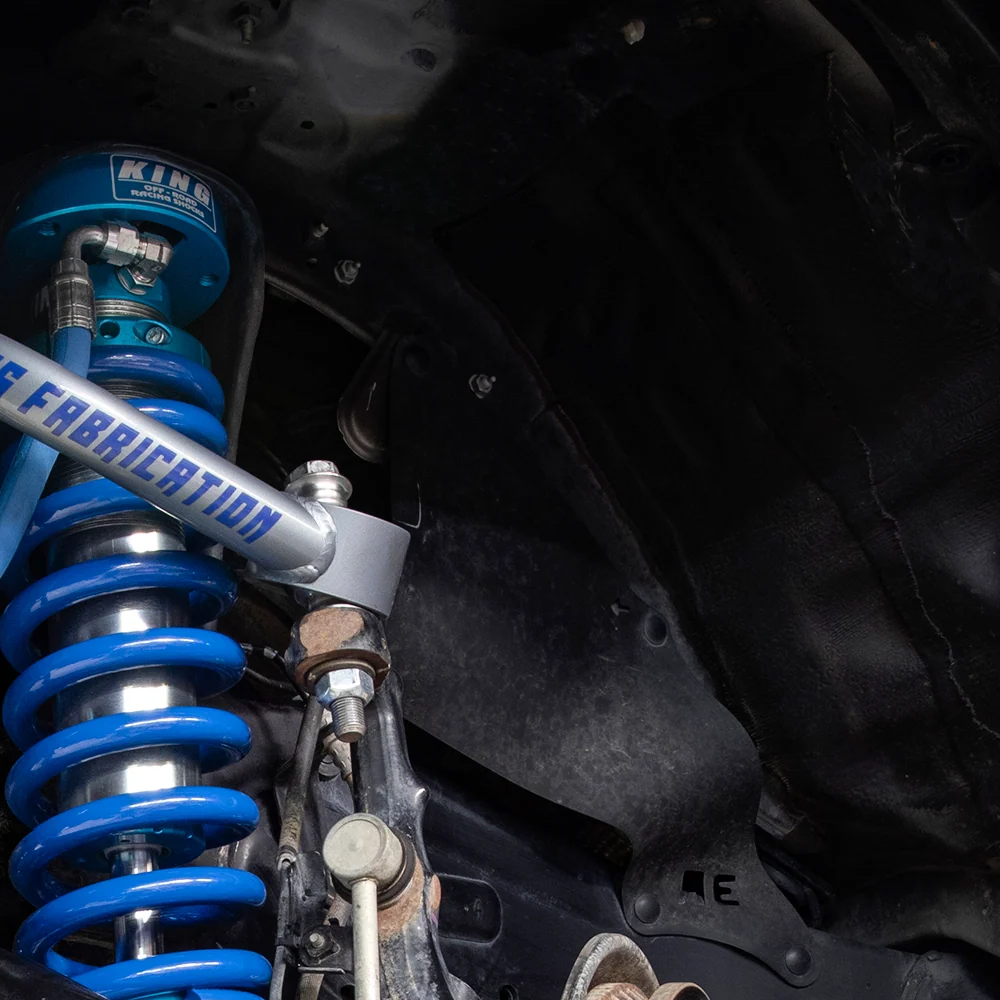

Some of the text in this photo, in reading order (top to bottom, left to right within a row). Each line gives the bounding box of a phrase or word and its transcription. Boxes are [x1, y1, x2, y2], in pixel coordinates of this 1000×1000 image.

[118, 159, 211, 206] KING
[131, 189, 205, 218] RACING SHOCKS
[17, 380, 283, 544] FABRICATION
